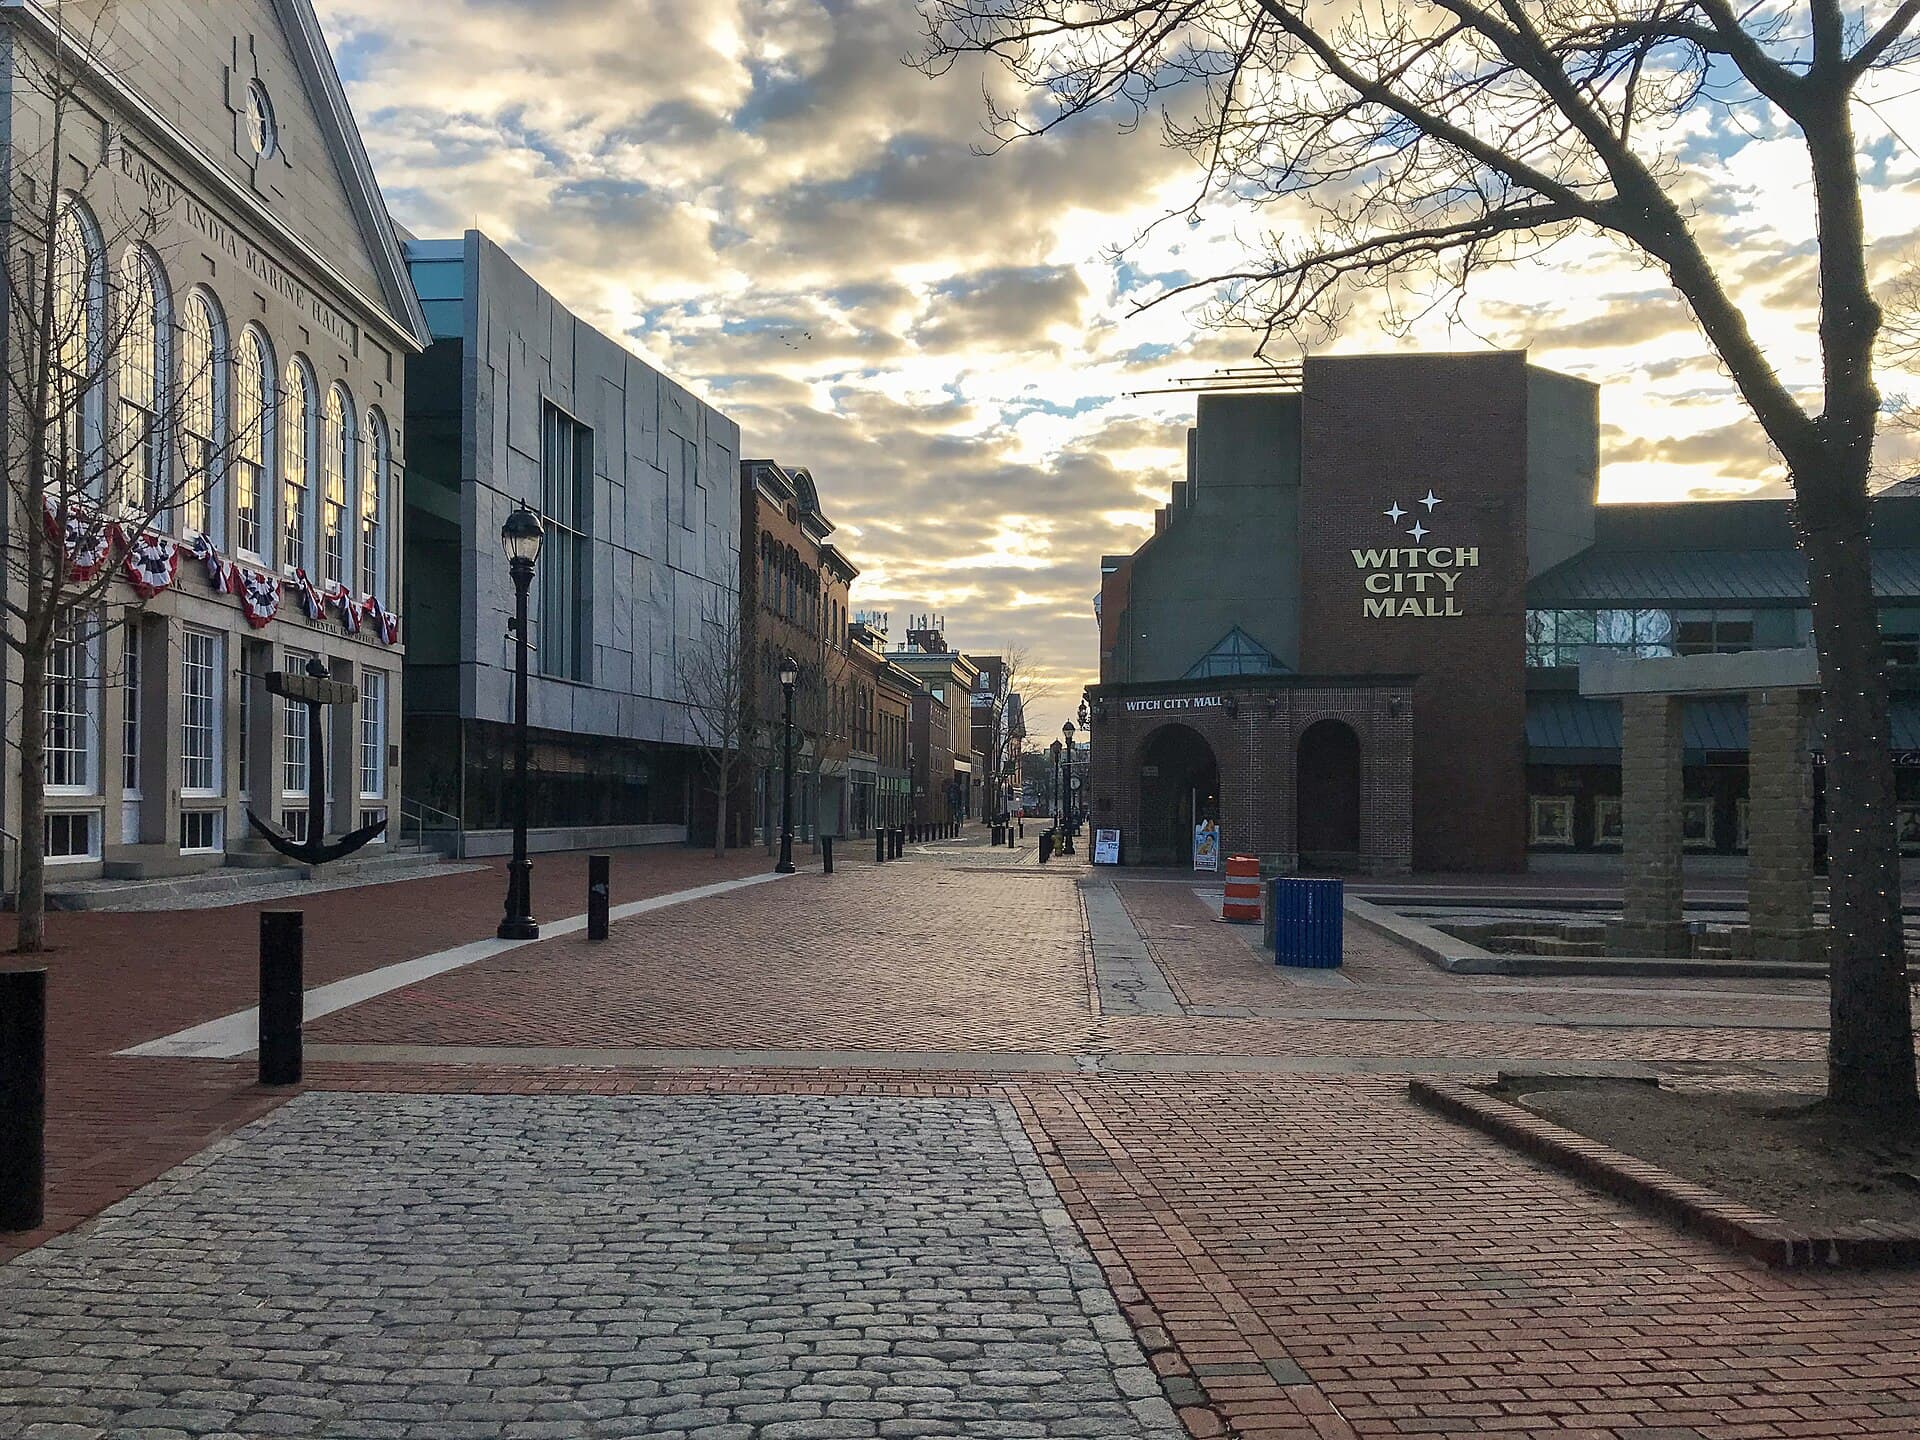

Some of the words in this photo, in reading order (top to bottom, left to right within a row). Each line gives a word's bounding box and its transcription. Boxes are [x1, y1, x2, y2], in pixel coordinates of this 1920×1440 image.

[120, 146, 176, 208] EAST
[185, 197, 237, 259] INDIA
[245, 246, 304, 310] MARINE
[1350, 547, 1479, 569] WITCH
[1364, 572, 1463, 594] CITY
[1363, 597, 1464, 618] MALL
[1126, 700, 1160, 711] WITCH
[1163, 698, 1190, 709] CITY
[1193, 696, 1223, 708] MALL
